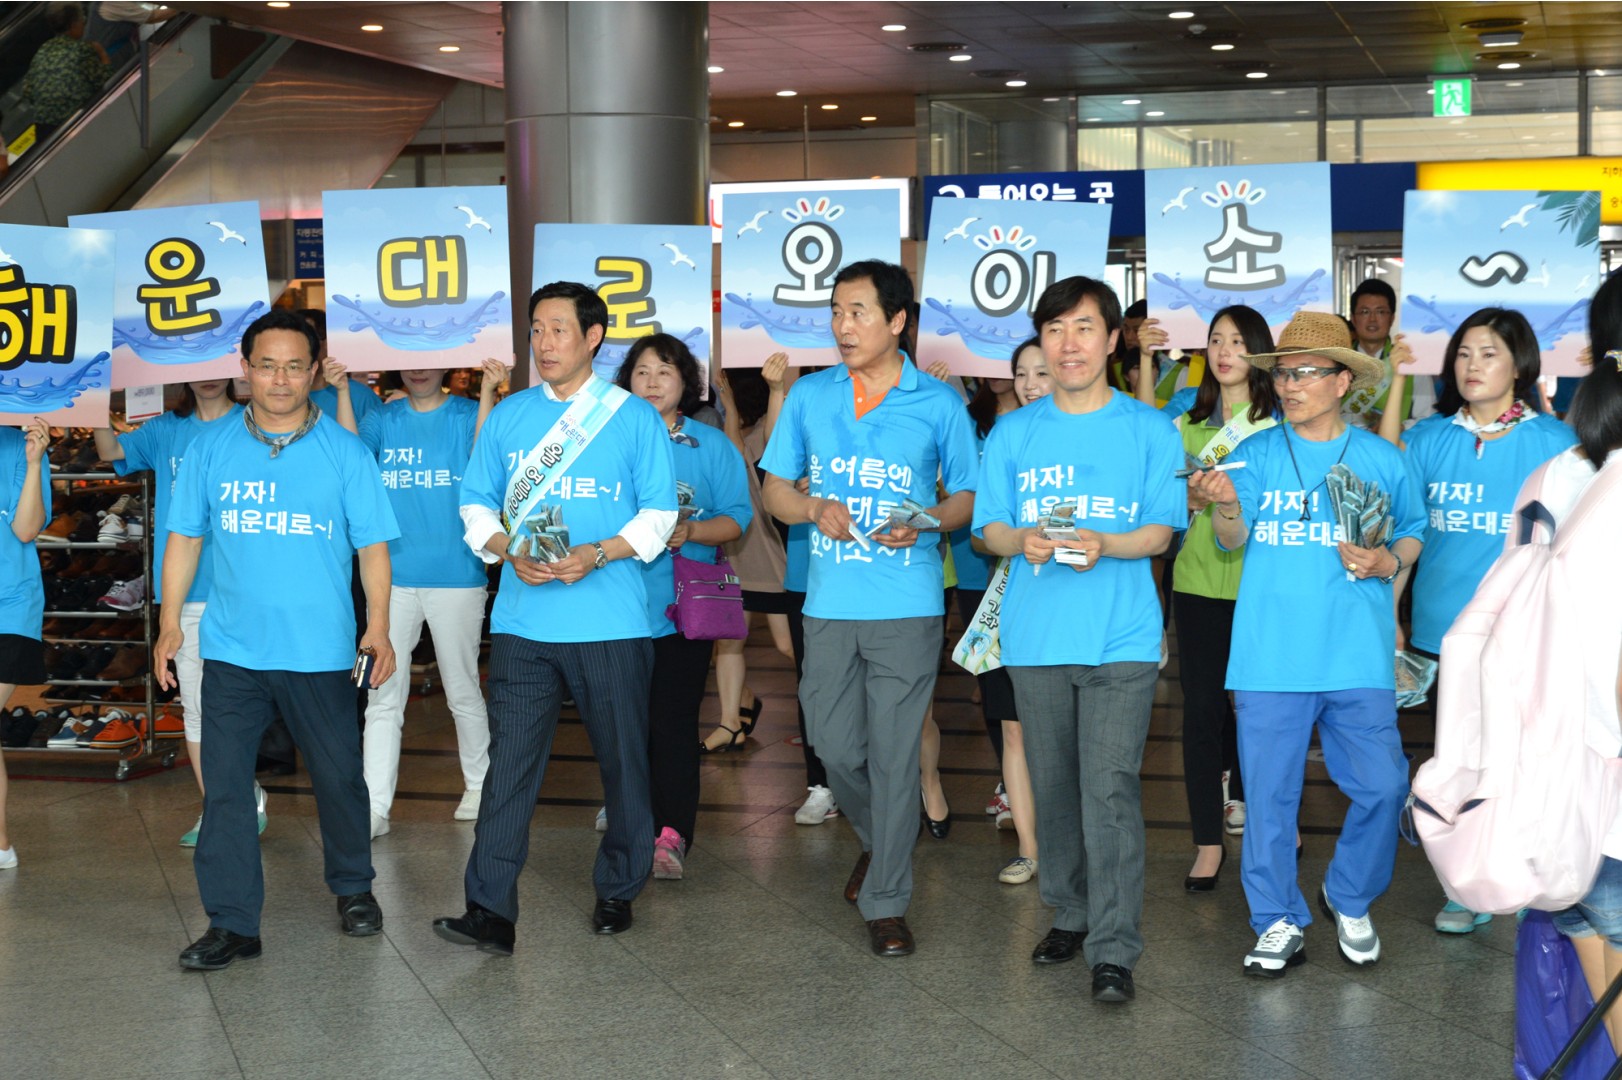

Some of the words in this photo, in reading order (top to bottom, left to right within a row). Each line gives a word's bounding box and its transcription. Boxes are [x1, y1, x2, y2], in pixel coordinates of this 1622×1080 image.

[377, 235, 467, 307] 대
[773, 221, 842, 308] 오
[1204, 202, 1282, 291] 소
[137, 237, 222, 336] 운
[596, 256, 655, 346] 로
[971, 249, 1056, 318] 이
[0, 264, 77, 371] 해
[383, 447, 423, 466] 가자!
[830, 455, 912, 495] 여름엔
[1018, 464, 1075, 493] 가자!
[219, 480, 276, 505] 가자!
[1259, 489, 1319, 515] 가자!
[1428, 481, 1484, 505] 가자!
[220, 509, 333, 540] 해운대로~!
